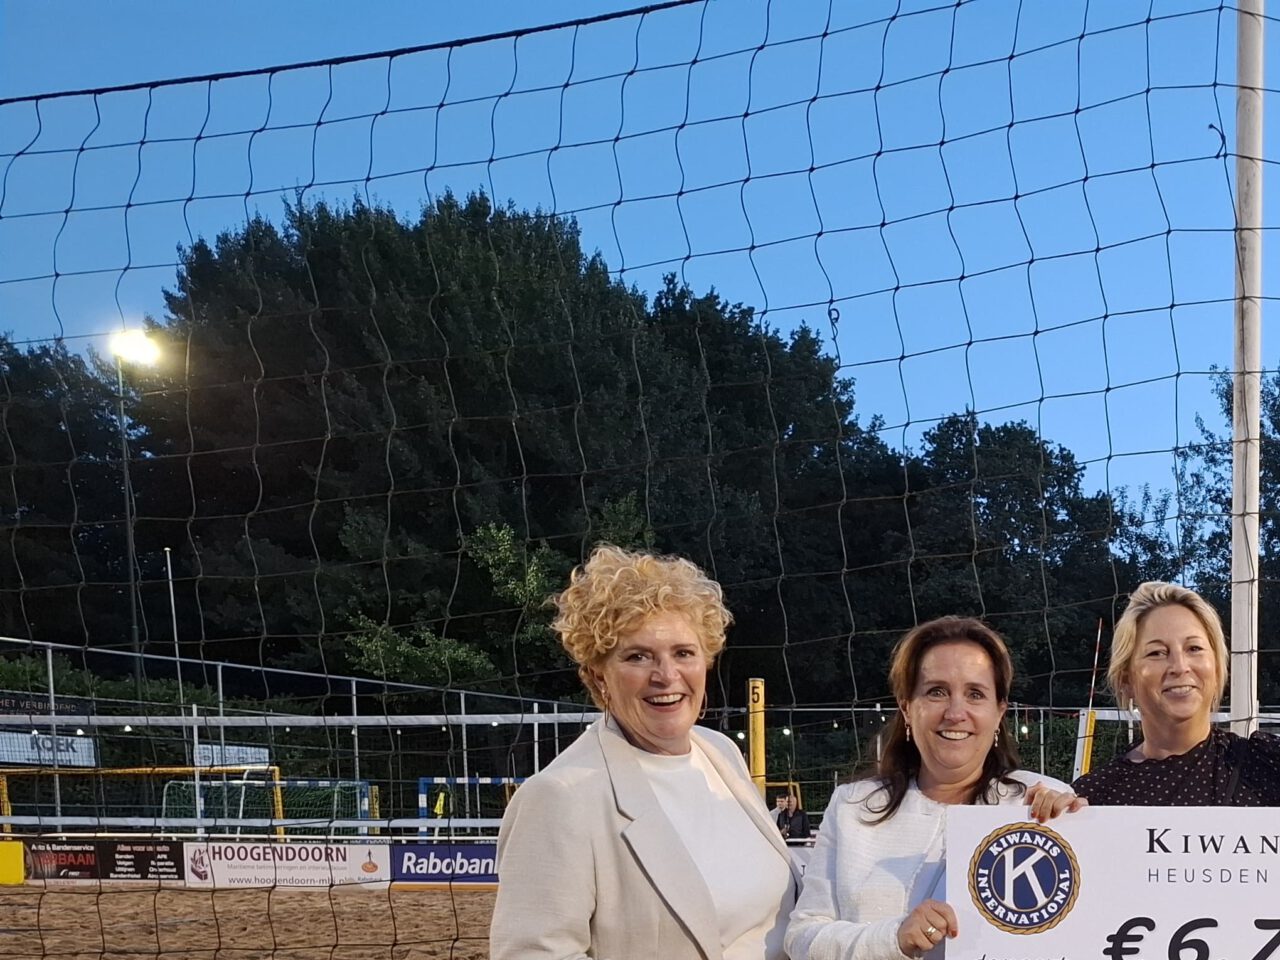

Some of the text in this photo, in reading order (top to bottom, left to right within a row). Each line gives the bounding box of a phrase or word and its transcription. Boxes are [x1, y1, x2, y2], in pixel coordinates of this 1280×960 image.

[752, 686, 760, 703] 5
[988, 832, 1061, 857] KIWANIS
[211, 845, 347, 862] HOOGENDOORN
[1148, 868, 1268, 884] HEUSDEN
[977, 868, 1071, 925] INTERNATIONAL
